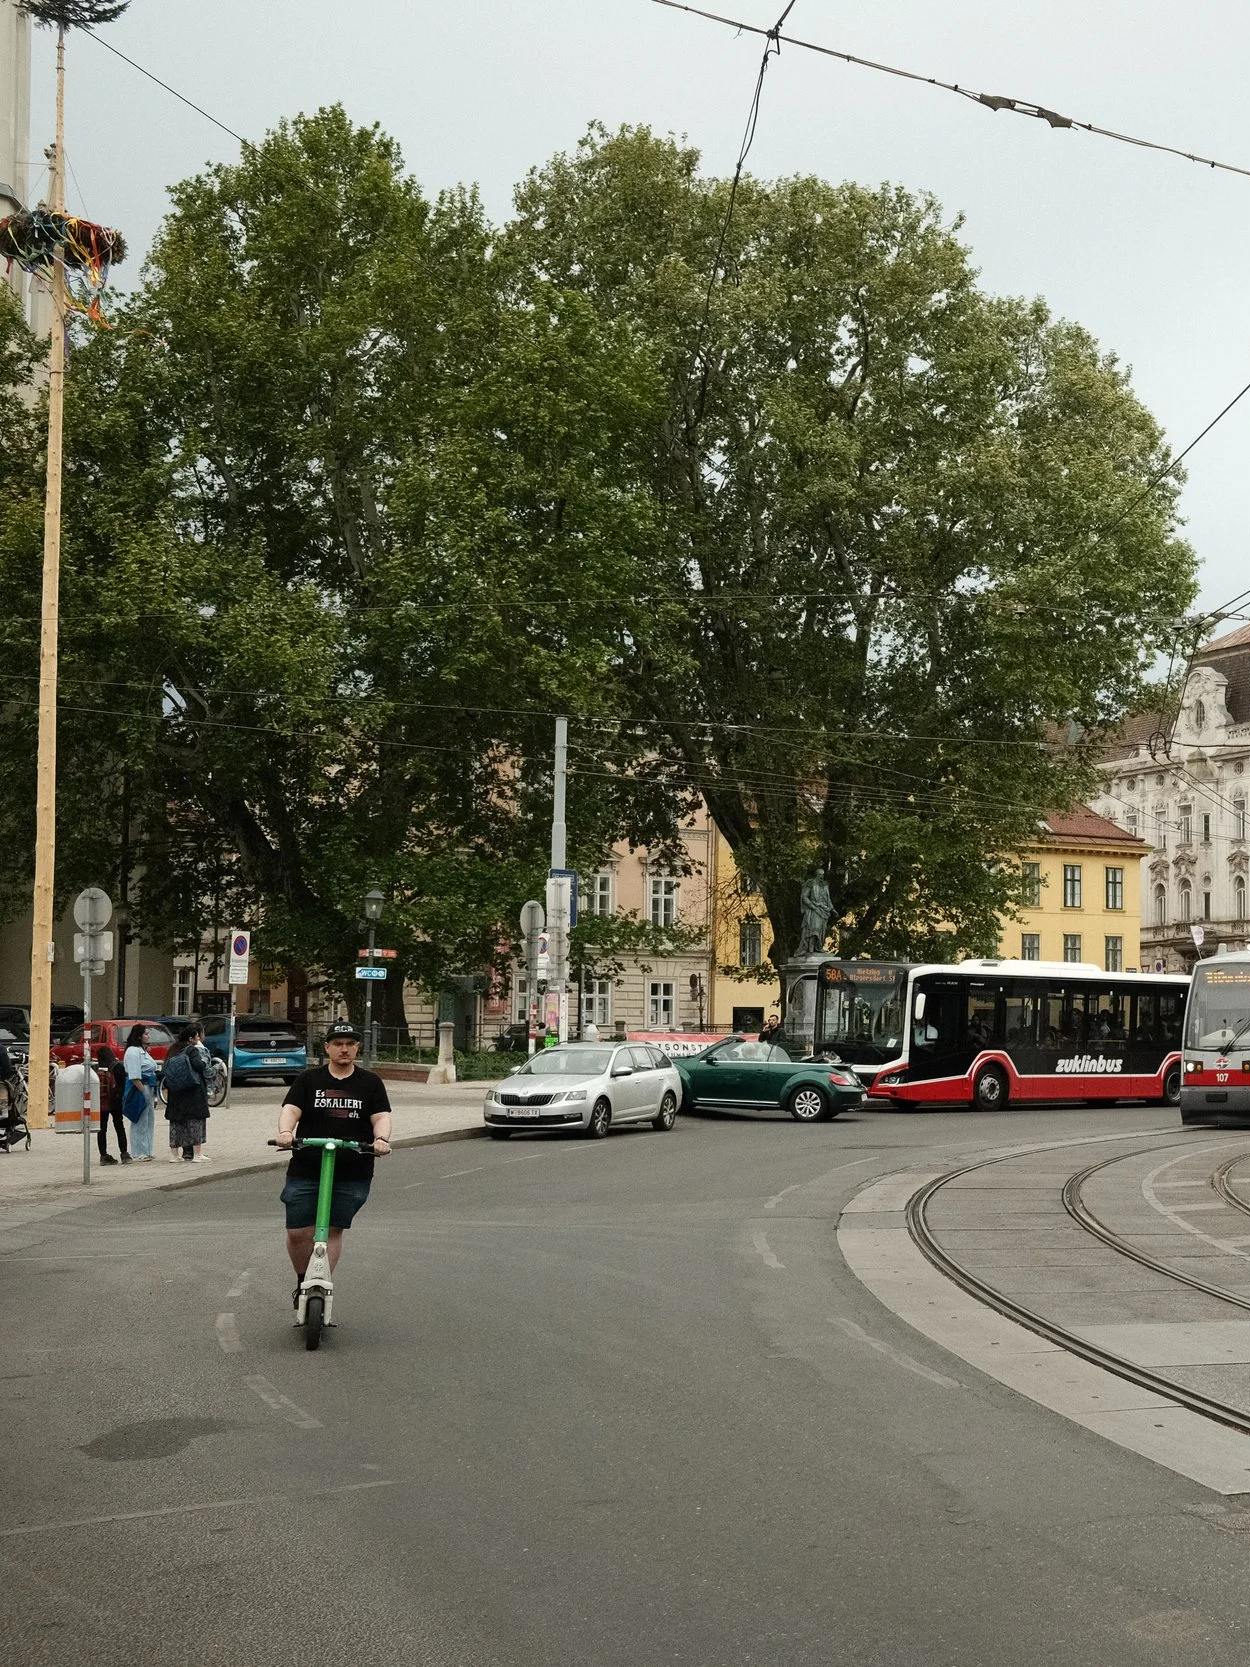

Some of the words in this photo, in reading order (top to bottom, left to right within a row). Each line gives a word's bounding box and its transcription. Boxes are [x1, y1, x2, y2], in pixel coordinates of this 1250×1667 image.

[825, 968, 842, 980] 58A
[1055, 1055, 1123, 1073] zuklinbus
[1216, 1073, 1229, 1082] 107
[315, 1089, 326, 1098] Es
[314, 1098, 363, 1109] ESKALIERT
